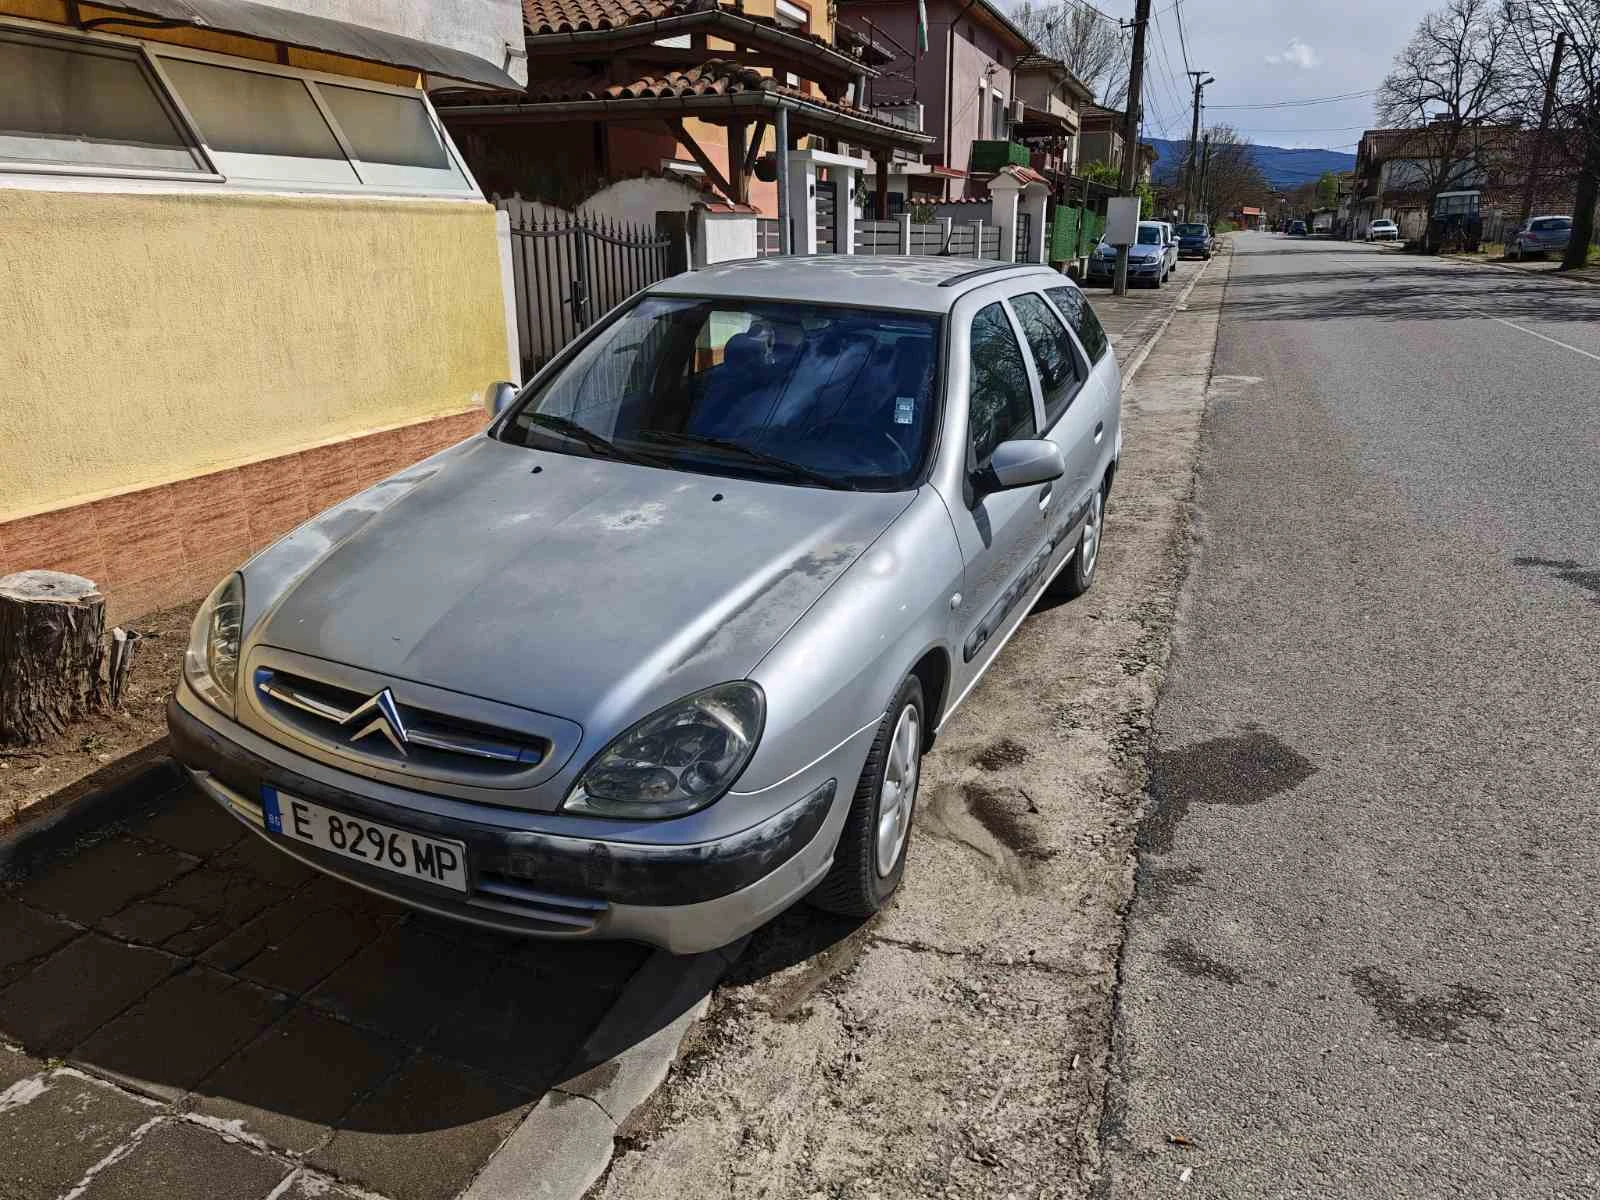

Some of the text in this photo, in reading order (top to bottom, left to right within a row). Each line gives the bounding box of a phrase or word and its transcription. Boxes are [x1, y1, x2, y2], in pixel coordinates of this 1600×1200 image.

[291, 801, 457, 881] E 8296 MP
